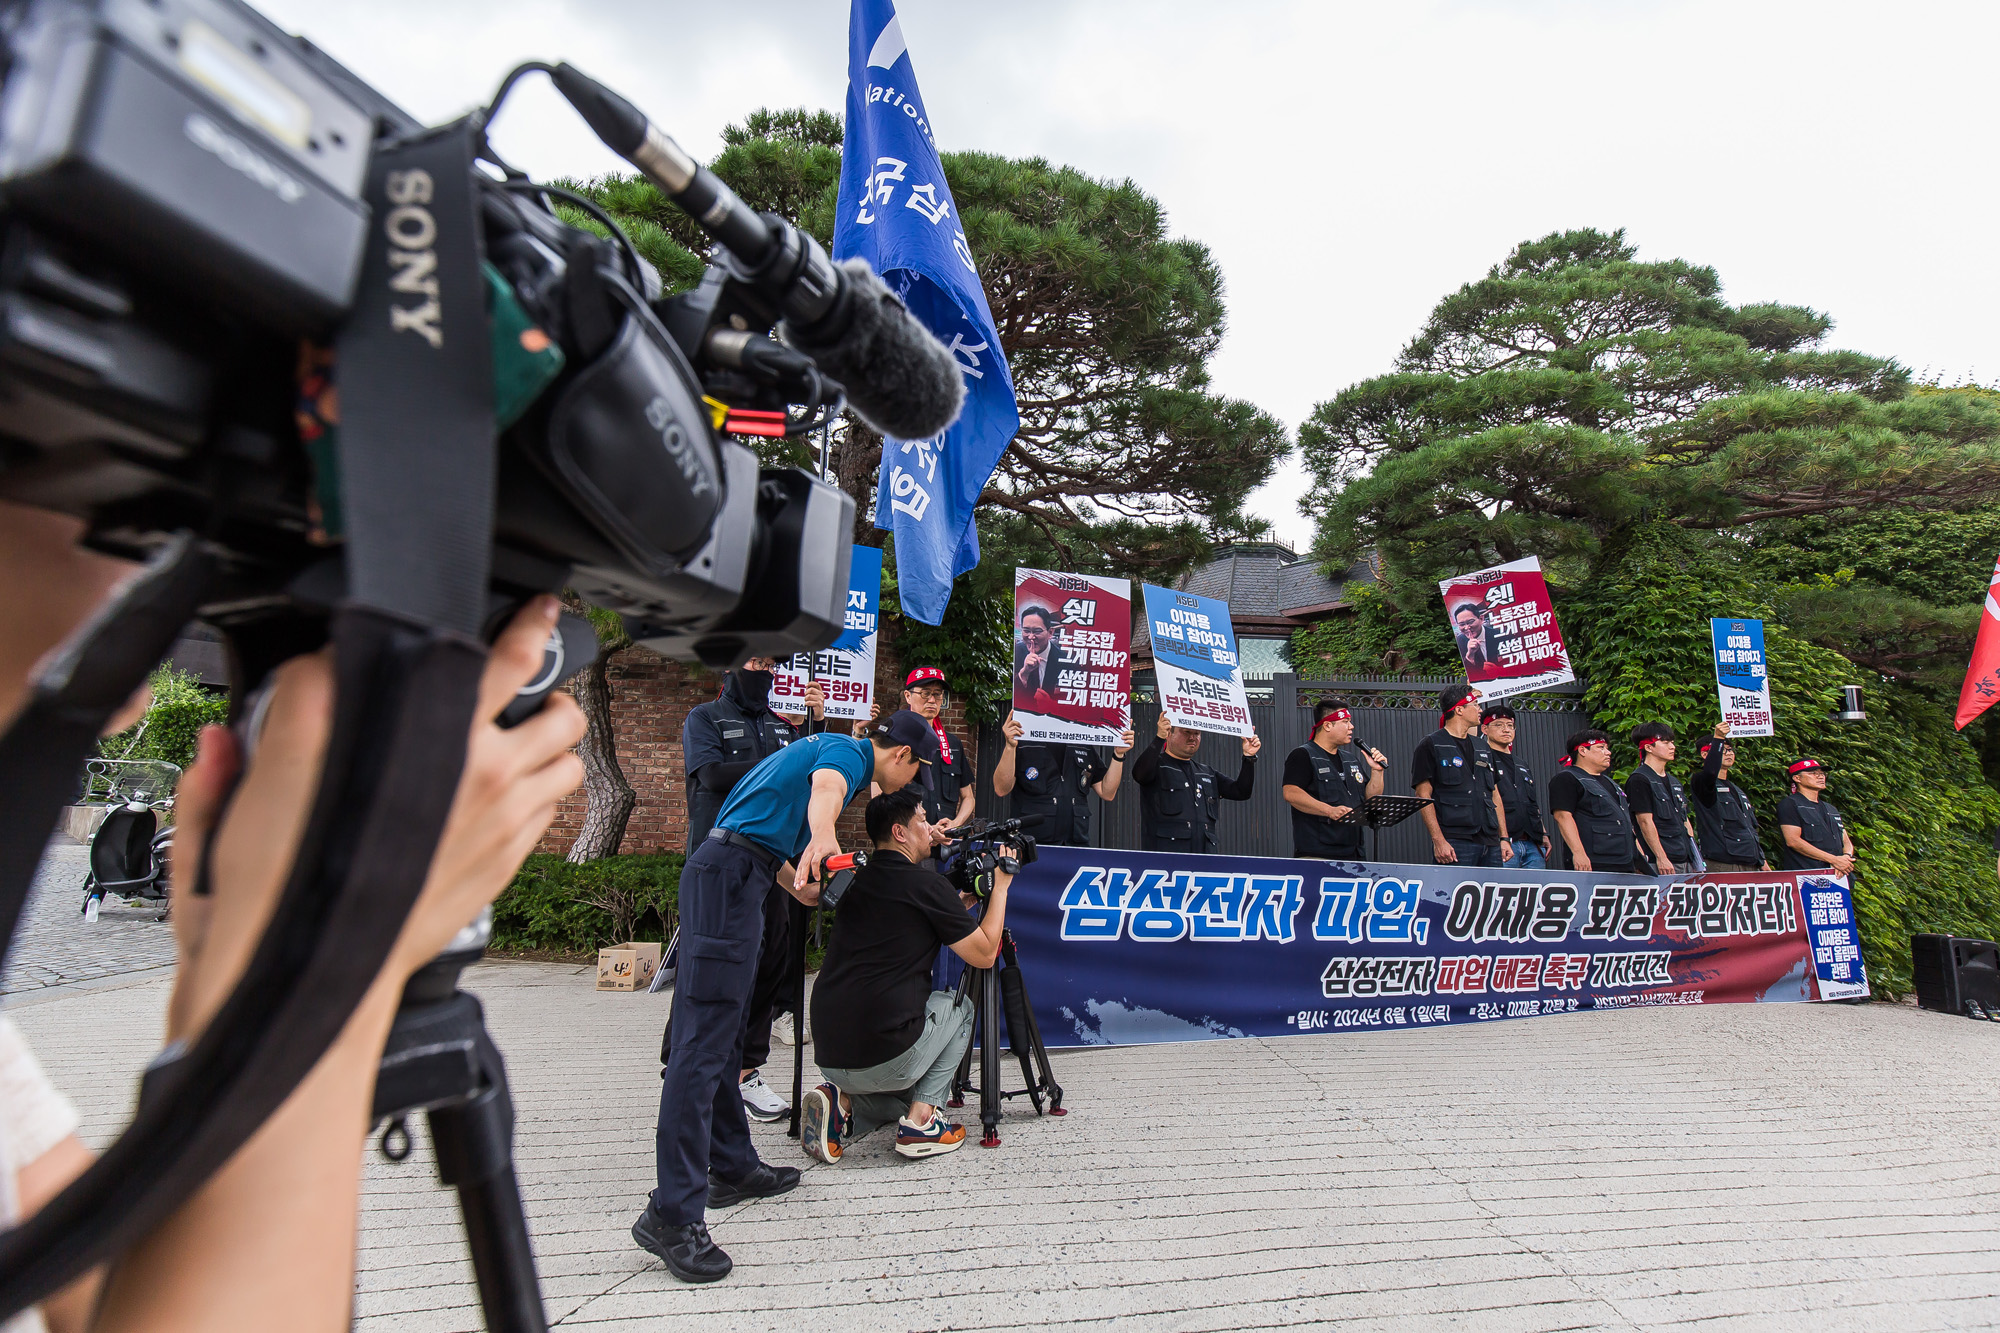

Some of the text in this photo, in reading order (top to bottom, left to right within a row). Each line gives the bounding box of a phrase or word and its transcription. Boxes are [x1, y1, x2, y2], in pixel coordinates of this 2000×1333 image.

[384, 168, 443, 349] SONY
[645, 396, 712, 498] SONY
[1059, 578, 1089, 592] NSEU
[1476, 570, 1503, 585] NSEU
[1175, 594, 1199, 609] NSEU
[1485, 582, 1515, 609] 쉿!
[1062, 598, 1096, 626] 쉿!
[1170, 609, 1211, 630] 이재용
[1489, 601, 1537, 625] 노동조합
[1154, 621, 1227, 649] 파업 참여자
[1493, 612, 1552, 638] 그게 뭐야?
[1059, 628, 1115, 649] 노동조합
[1498, 630, 1550, 655] 삼성 파업
[1727, 636, 1751, 649] 이재용
[1058, 647, 1127, 668] 그게 뭐야?
[1154, 636, 1237, 667] 블랙리스트 관리!
[1502, 642, 1561, 668] 그게 뭐야?
[1719, 650, 1760, 663] 파업 참여자
[1058, 669, 1119, 690] 삼성 파업
[1176, 677, 1231, 702] 지속되는
[769, 701, 783, 709] SEU
[1058, 688, 1127, 709] 그게 뭐야?
[1166, 694, 1248, 724] 부당노동행위
[1730, 695, 1761, 709] 지속되는
[1725, 711, 1770, 726] 부당노동행위
[1030, 730, 1113, 743] NSEU 전국삼성전자노동조합
[1058, 866, 1797, 945] 삼성전자 파업, 이재용 회장 책임져라!
[1810, 892, 1843, 908] 조합원은
[1810, 908, 1849, 925] 파업 참여!
[1817, 929, 1850, 946] 이재용은
[1816, 945, 1859, 963] 파리 올림픽
[1320, 951, 1673, 998] 삼성전자 파업 해결 촉구 기자회견
[1831, 962, 1851, 979] 관람!
[1297, 1010, 1329, 1029] 일시:
[1333, 1007, 1382, 1027] 2024년
[1384, 1007, 1407, 1024] 8월
[1410, 1004, 1450, 1023] 1일(목)
[1477, 1002, 1504, 1020] 장소:
[1507, 1000, 1540, 1017] 이재용
